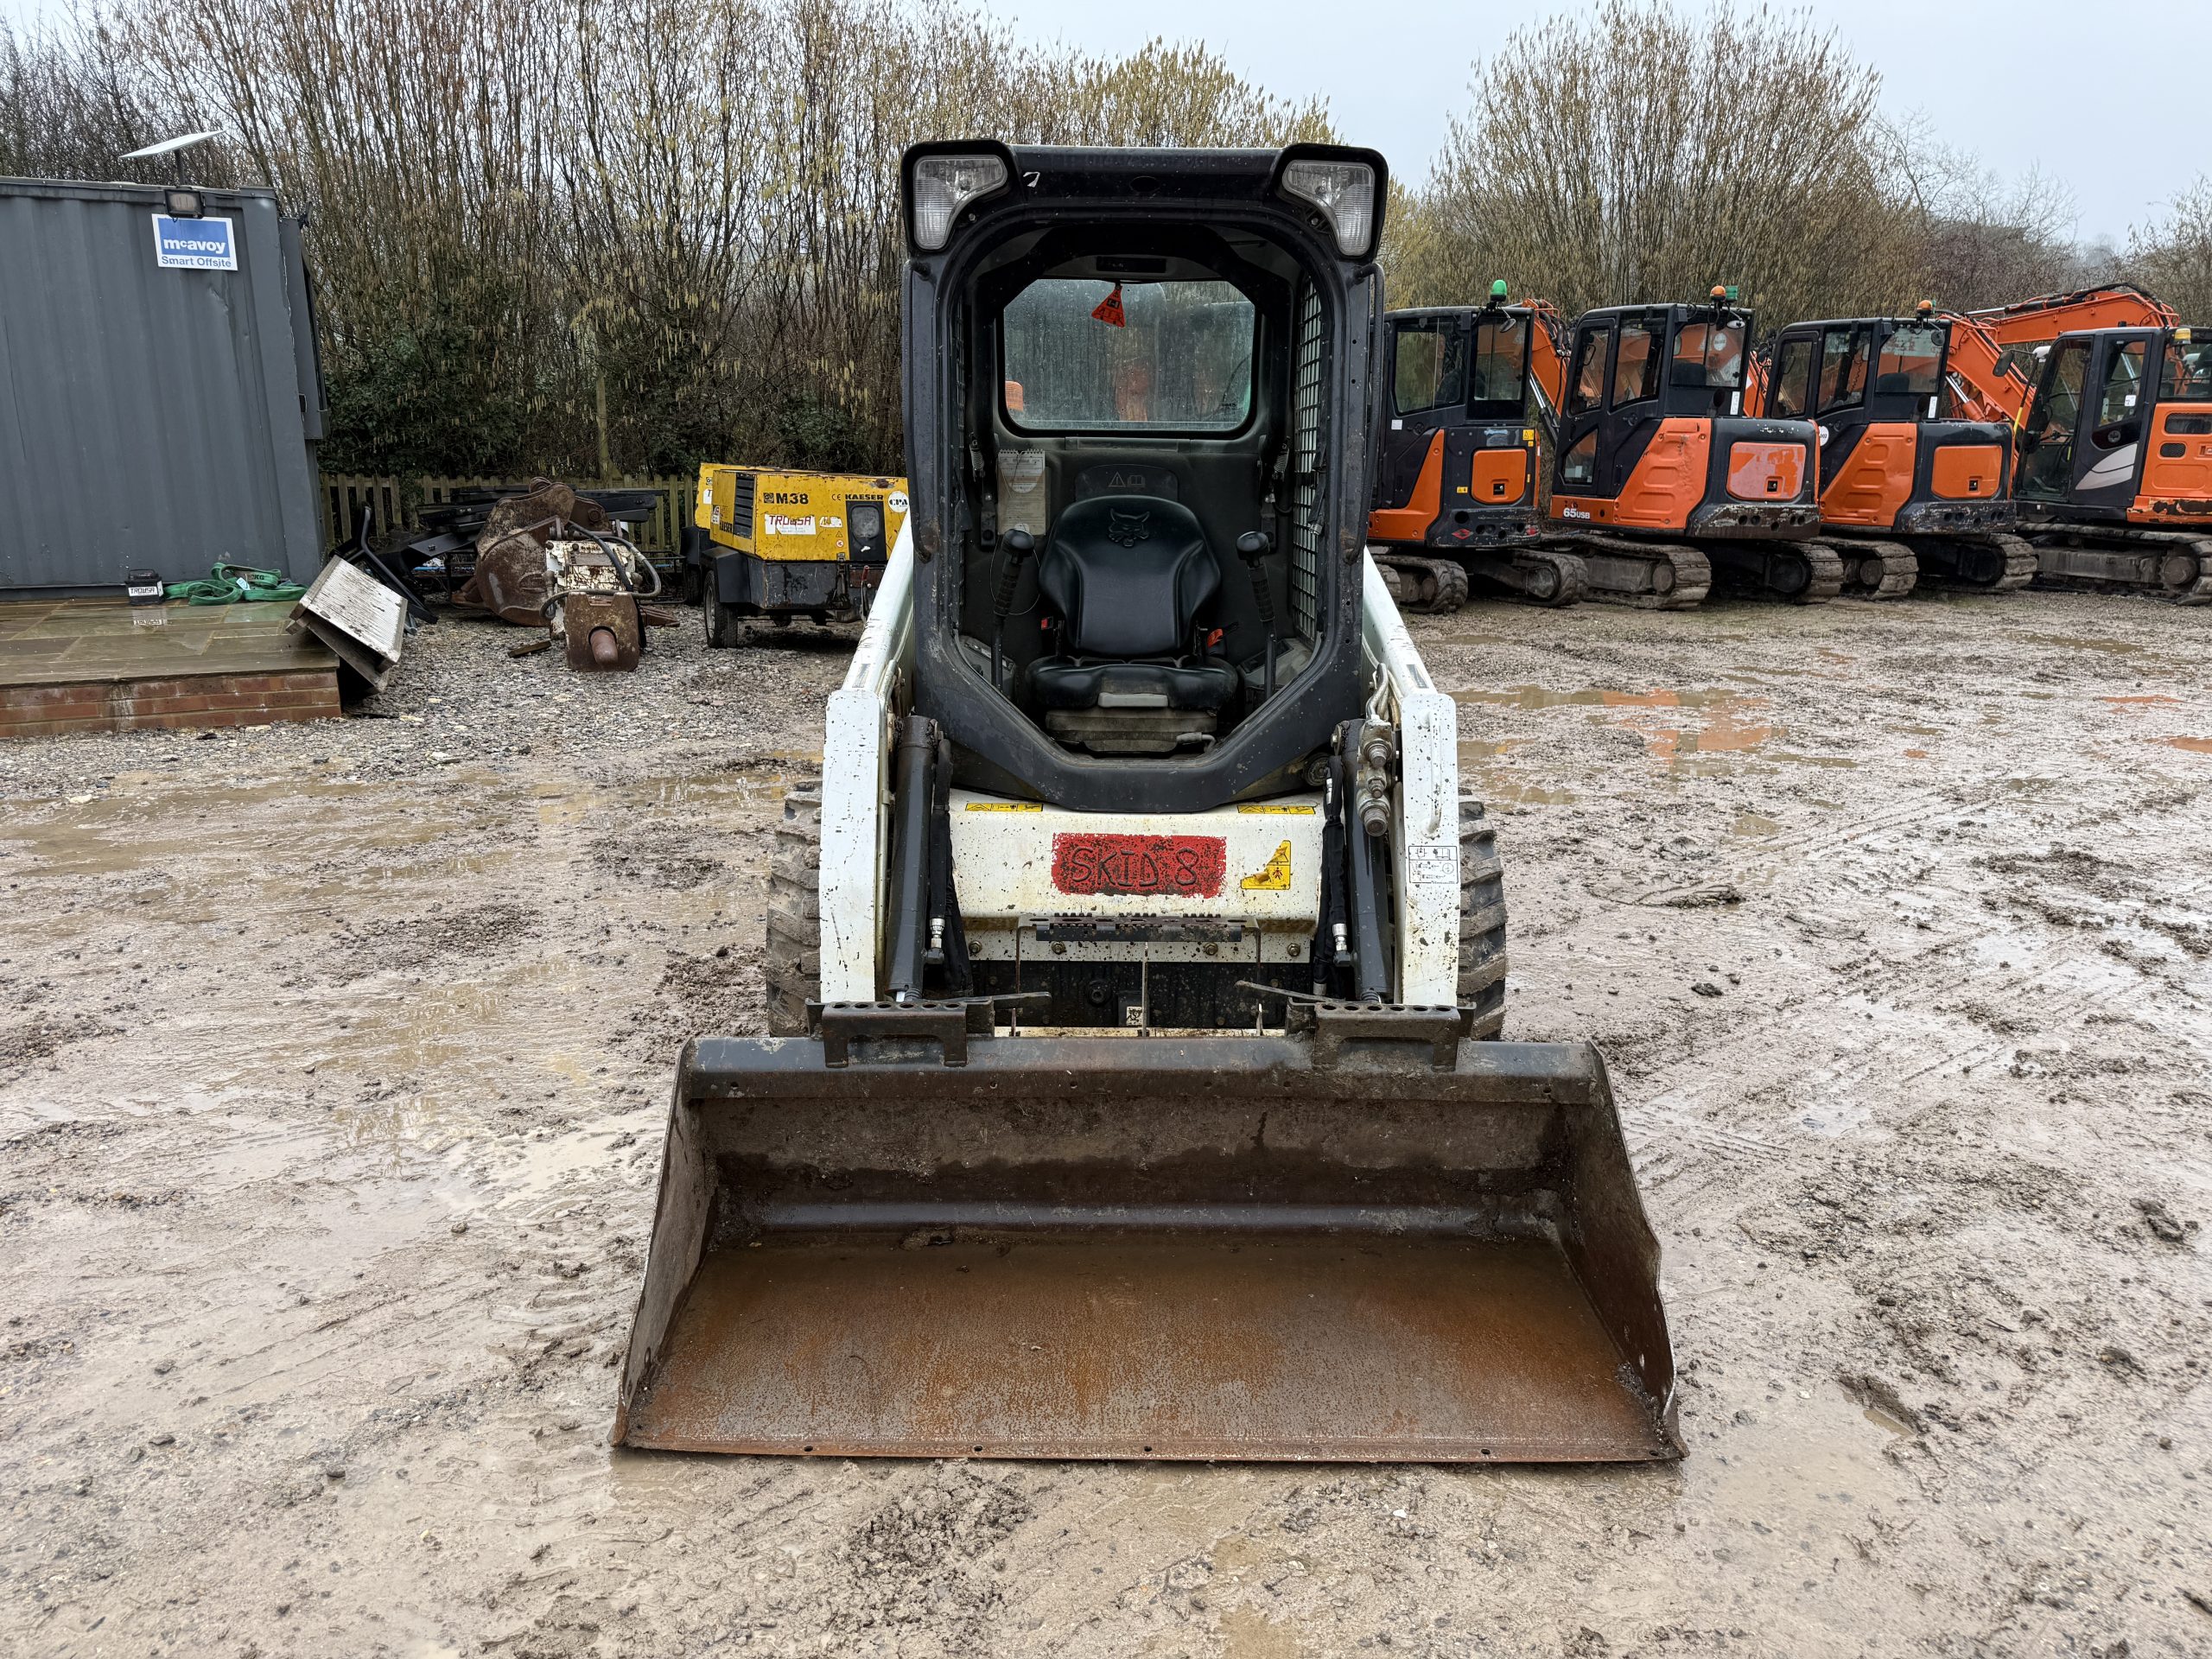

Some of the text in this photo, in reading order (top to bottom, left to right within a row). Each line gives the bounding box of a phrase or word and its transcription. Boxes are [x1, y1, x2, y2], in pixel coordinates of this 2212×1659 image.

[162, 256, 231, 267] Smart Offsite
[776, 493, 809, 505] M38
[1563, 507, 1591, 519] 65USB
[1071, 847, 1199, 887] SKID 8
